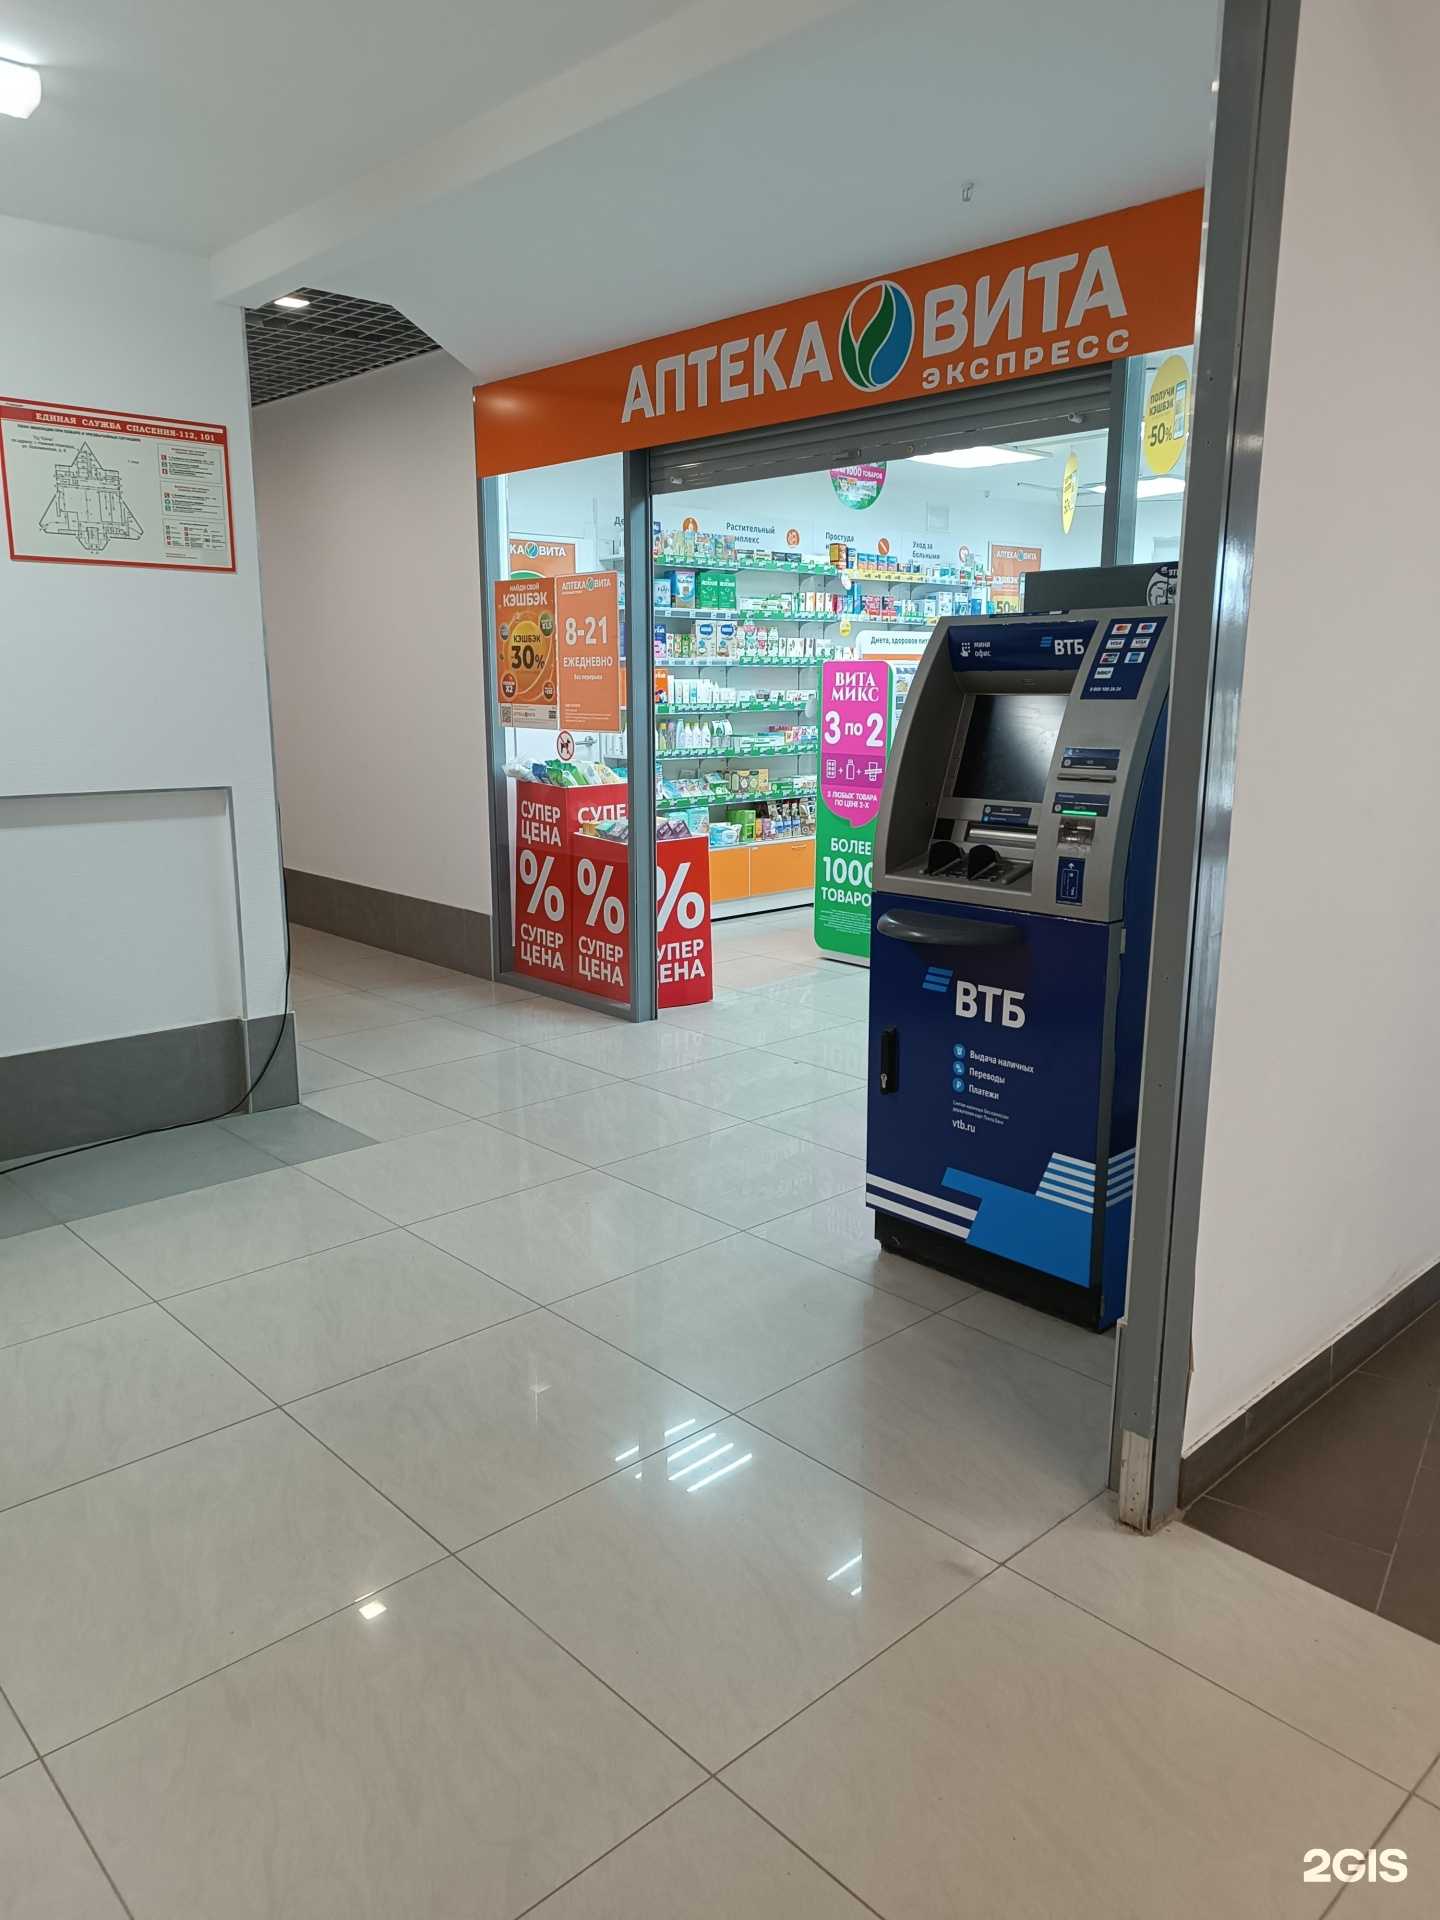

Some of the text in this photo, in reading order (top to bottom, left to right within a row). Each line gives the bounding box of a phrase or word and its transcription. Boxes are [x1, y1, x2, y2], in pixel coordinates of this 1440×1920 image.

[621, 245, 1128, 424] АПТЕКА ВИТА
[922, 329, 1129, 389] ЭКСПРЕСС
[1150, 385, 1175, 405] ПОЛУЧИ
[35, 412, 77, 425] ЕДИНАЯ
[81, 418, 122, 431] СЛУЖБА
[200, 433, 215, 442] 101
[1147, 422, 1172, 447] -50%
[726, 521, 776, 535] Растительный
[825, 531, 855, 543] Простуда
[539, 545, 567, 557] ВИТА
[561, 580, 586, 591] АПТЕКА
[594, 578, 611, 589] ВИТА
[502, 591, 548, 607] КЭШБЭК
[513, 634, 541, 643] КЭШБЭК
[565, 615, 608, 646] 8-21
[511, 645, 545, 670] 30%
[1054, 638, 1084, 656] ВТБ
[563, 655, 613, 669] ЕЖЕДНЕВНО
[835, 671, 876, 687] ВИТА
[831, 686, 880, 702] МИКС
[824, 710, 841, 745] 3
[865, 712, 884, 748] 2
[856, 792, 878, 802] ТОВАРА
[520, 800, 561, 824] СУПЕР
[577, 804, 628, 824] СУПЕ
[520, 819, 562, 847] ЦЕНА
[830, 837, 872, 856] БОЛЕЕ
[820, 886, 872, 907] ТОВАРО
[520, 922, 564, 949] СУПЕР
[520, 941, 565, 972] ЦЕНА
[578, 935, 624, 963] СУПЕР
[656, 938, 705, 962] УПЕР
[578, 954, 625, 988] ЦЕНА
[658, 959, 706, 984] ЕНА
[955, 980, 1026, 1029] ВТБ
[969, 1049, 1035, 1074] Выдача наличных
[969, 1067, 1006, 1084] Переводы
[968, 1084, 1000, 1100] Платежи
[951, 1119, 976, 1133] vtb.ru
